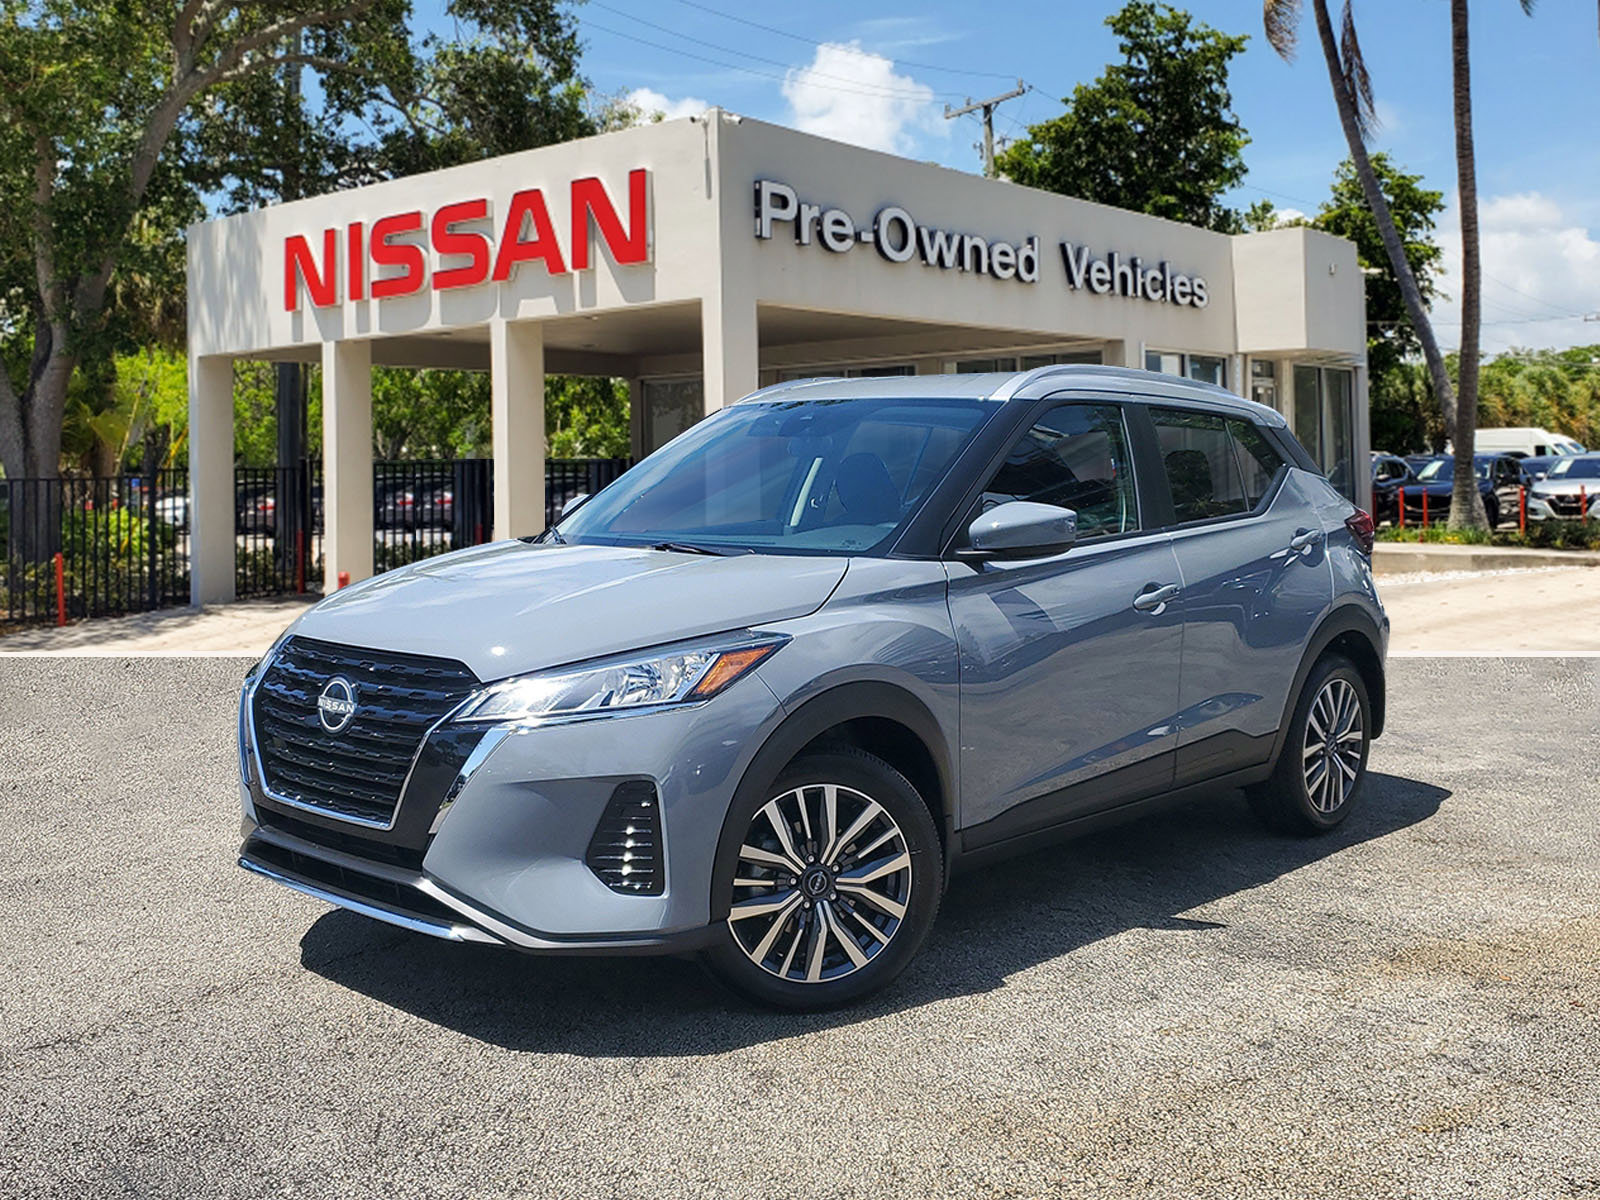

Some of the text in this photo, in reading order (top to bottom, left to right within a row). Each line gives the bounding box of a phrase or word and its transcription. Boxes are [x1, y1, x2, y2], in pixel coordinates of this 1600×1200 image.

[285, 168, 647, 311] NISSAN
[754, 179, 1209, 309] Pre-Owned Vehicles
[318, 697, 355, 714] NISSAN
